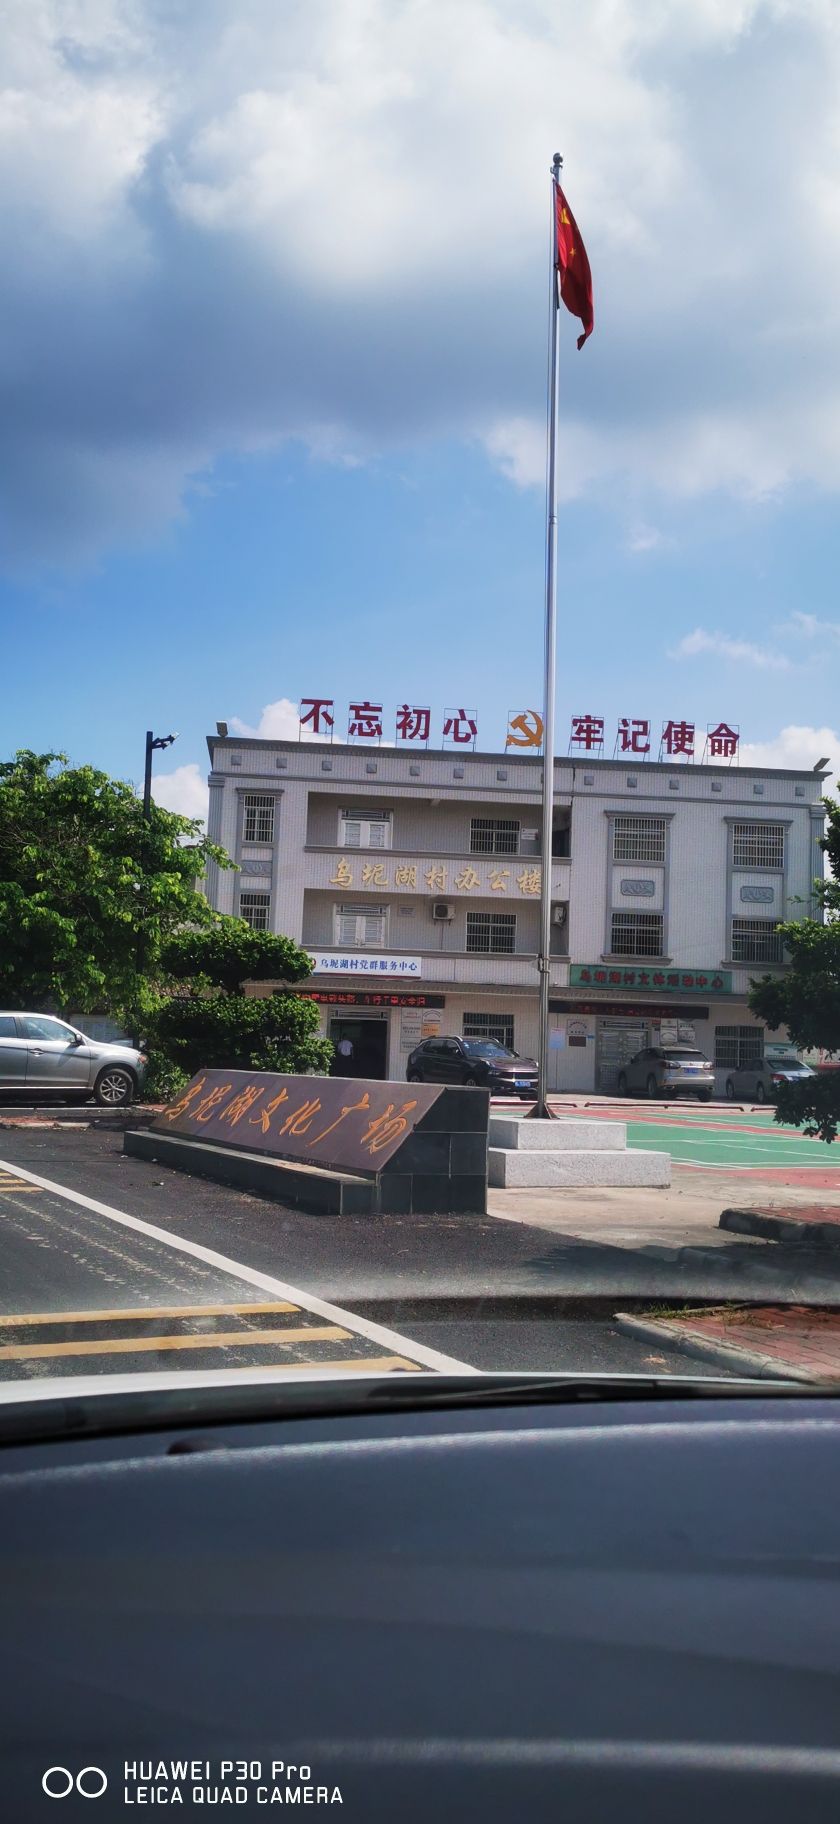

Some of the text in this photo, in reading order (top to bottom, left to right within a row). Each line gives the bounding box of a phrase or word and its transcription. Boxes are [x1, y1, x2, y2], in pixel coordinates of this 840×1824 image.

[300, 698, 740, 757] 不忘初心 牢记使命
[329, 857, 542, 895] 乌坭湖村办公楼
[320, 958, 418, 971] 乌坭湖村党群服务中心
[164, 1076, 418, 1154] 乌坭湖文化广场
